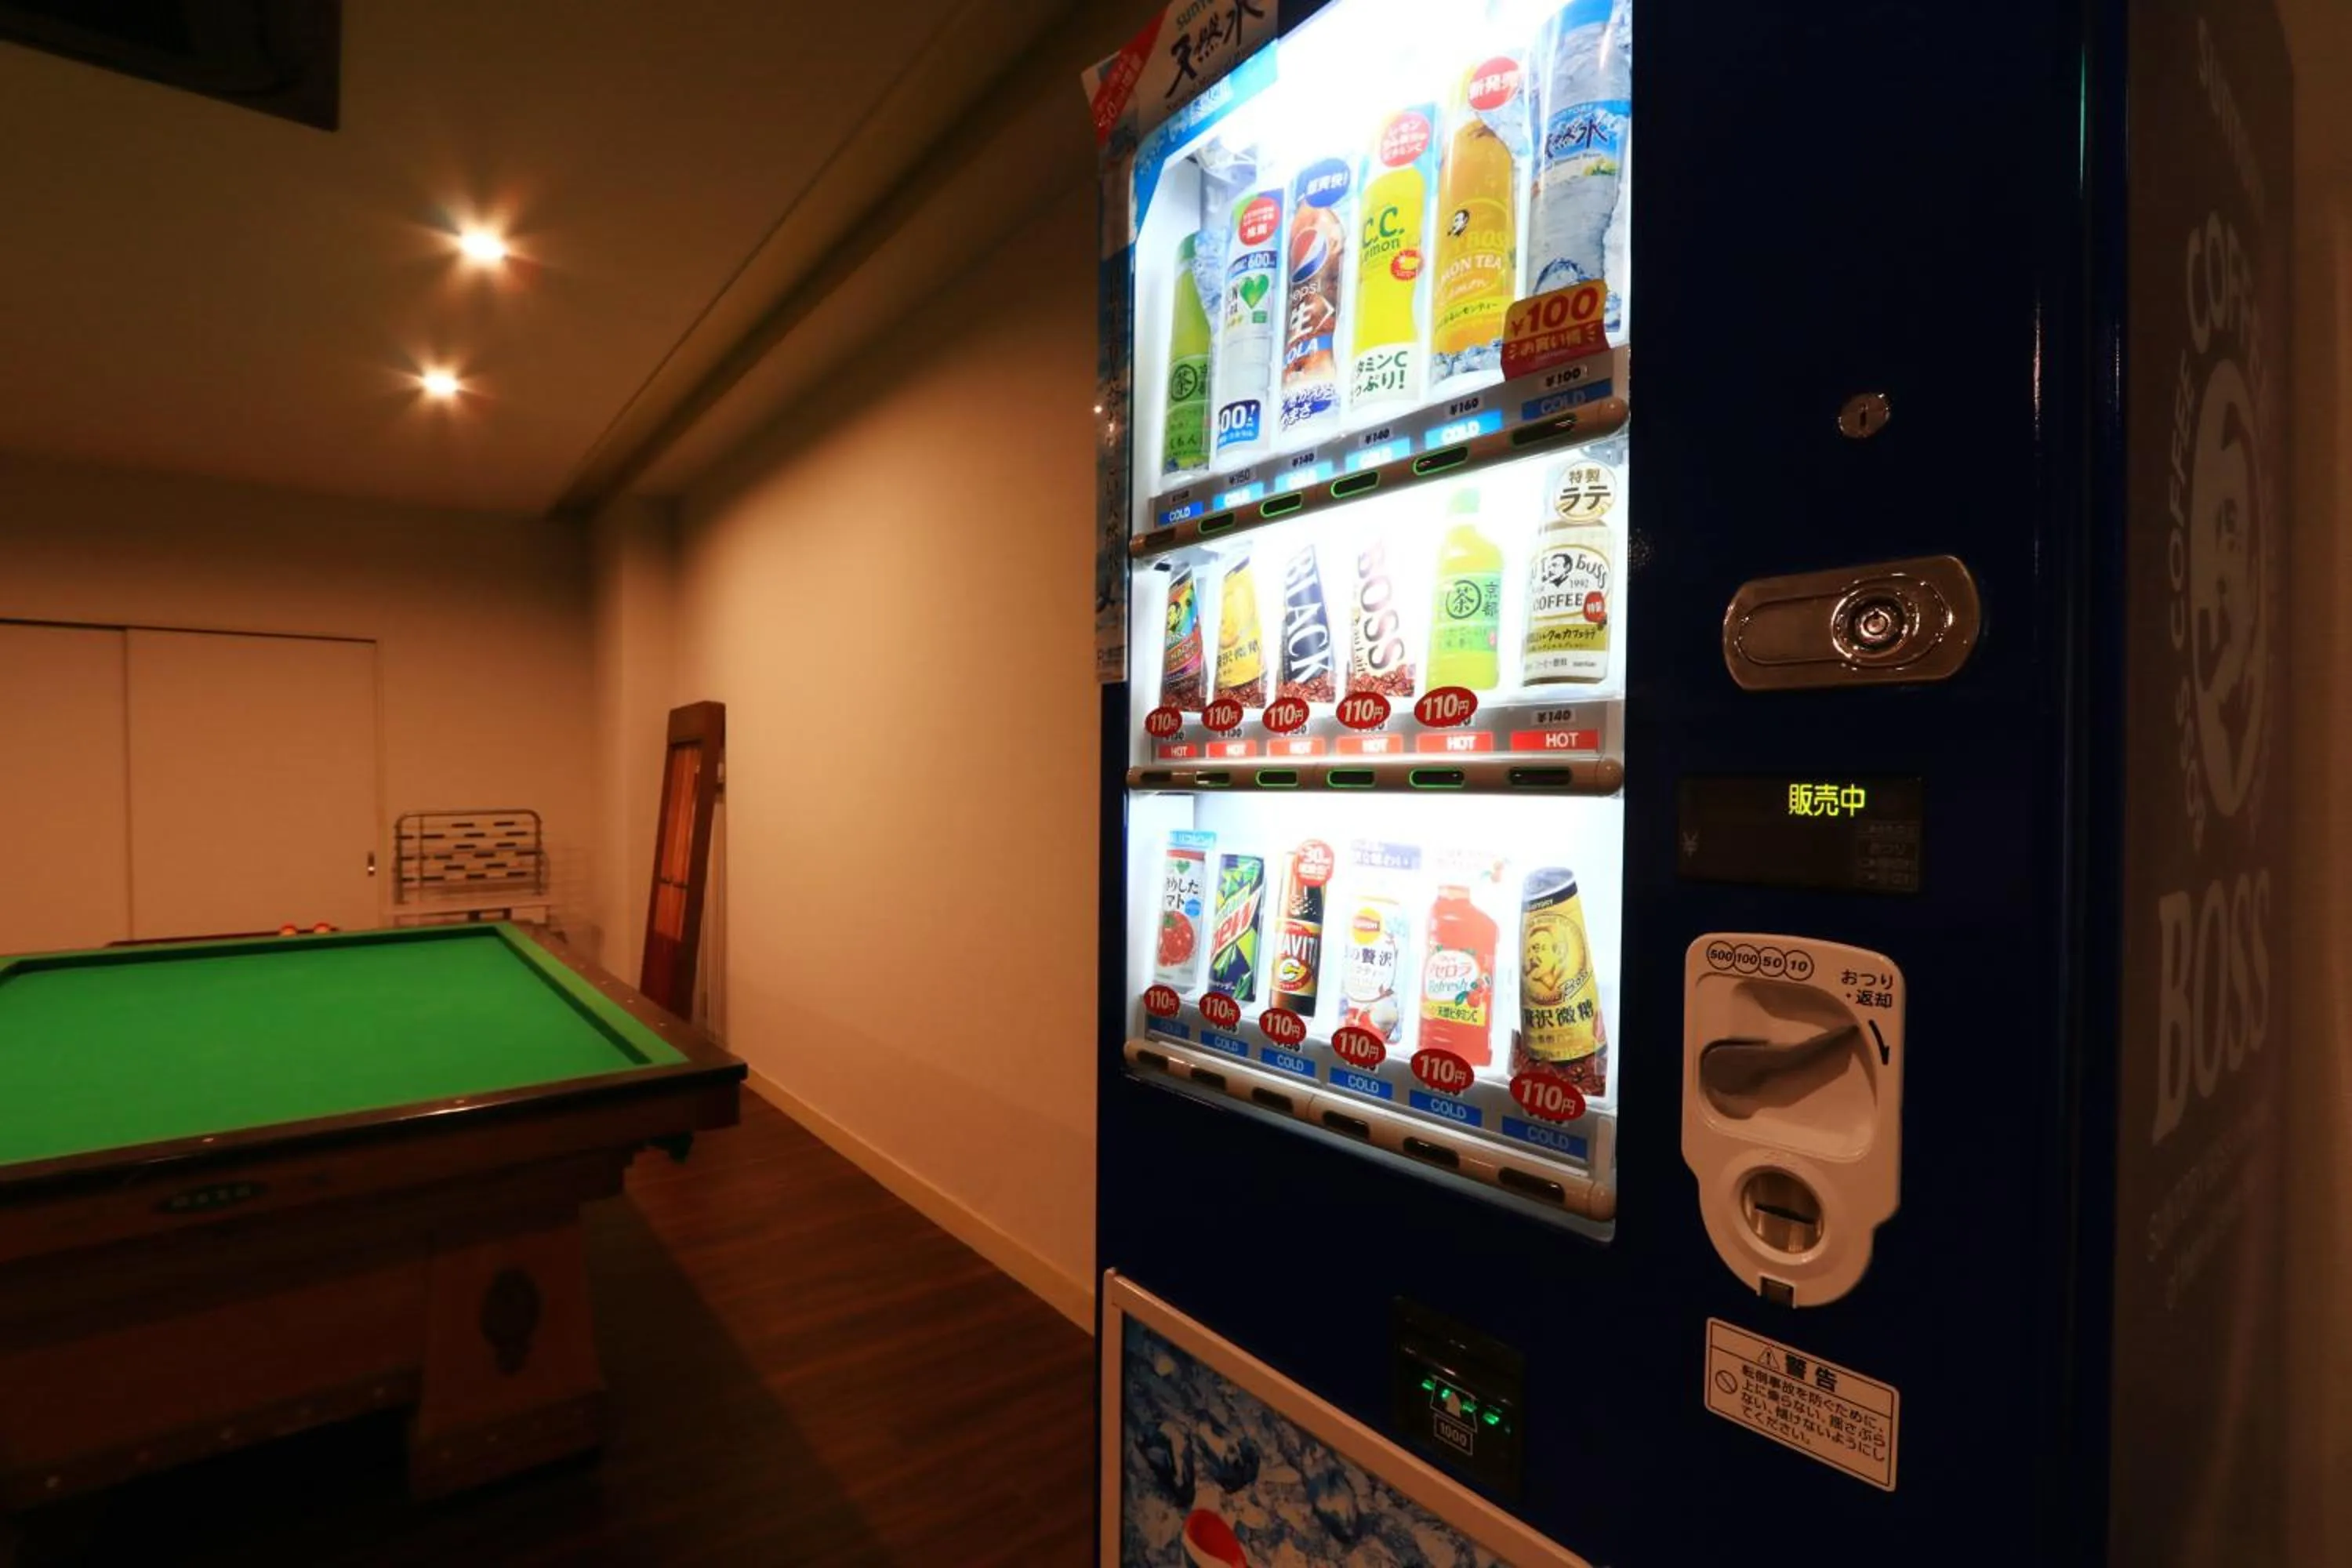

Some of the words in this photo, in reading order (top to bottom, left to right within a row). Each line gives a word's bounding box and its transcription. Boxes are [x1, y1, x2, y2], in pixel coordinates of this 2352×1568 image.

[1360, 238, 1399, 261] emon
[1511, 286, 1599, 336] ¥100
[1545, 368, 1581, 387] ¥100
[1541, 391, 1586, 414] COLD
[1559, 485, 1611, 514] ラテ
[1285, 544, 1334, 684] BLACK
[1269, 703, 1304, 728] 110円
[1344, 699, 1384, 723] 110円
[1423, 694, 1470, 721] 110円
[1537, 710, 1572, 724] ¥140
[1446, 735, 1477, 750] HOT
[1545, 732, 1579, 748] HOT
[1788, 783, 1865, 818] 販売中
[1710, 949, 1733, 961] 500
[1737, 952, 1757, 965] 100
[1763, 956, 1782, 968] 50
[1790, 960, 1808, 972] 10
[1842, 968, 1893, 989] おつり
[2152, 868, 2270, 1147] BOSS
[1265, 1013, 1301, 1039] 110円
[1215, 1036, 1239, 1052] COLD
[1339, 1031, 1380, 1060] 110円
[1276, 1054, 1305, 1073] COLD
[1419, 1055, 1467, 1086] 110円
[1347, 1074, 1380, 1094] COLD
[1430, 1098, 1467, 1120] COLD
[1520, 1079, 1576, 1116] 110円
[1527, 1125, 1569, 1150] COLD
[1439, 1422, 1468, 1447] 1000
